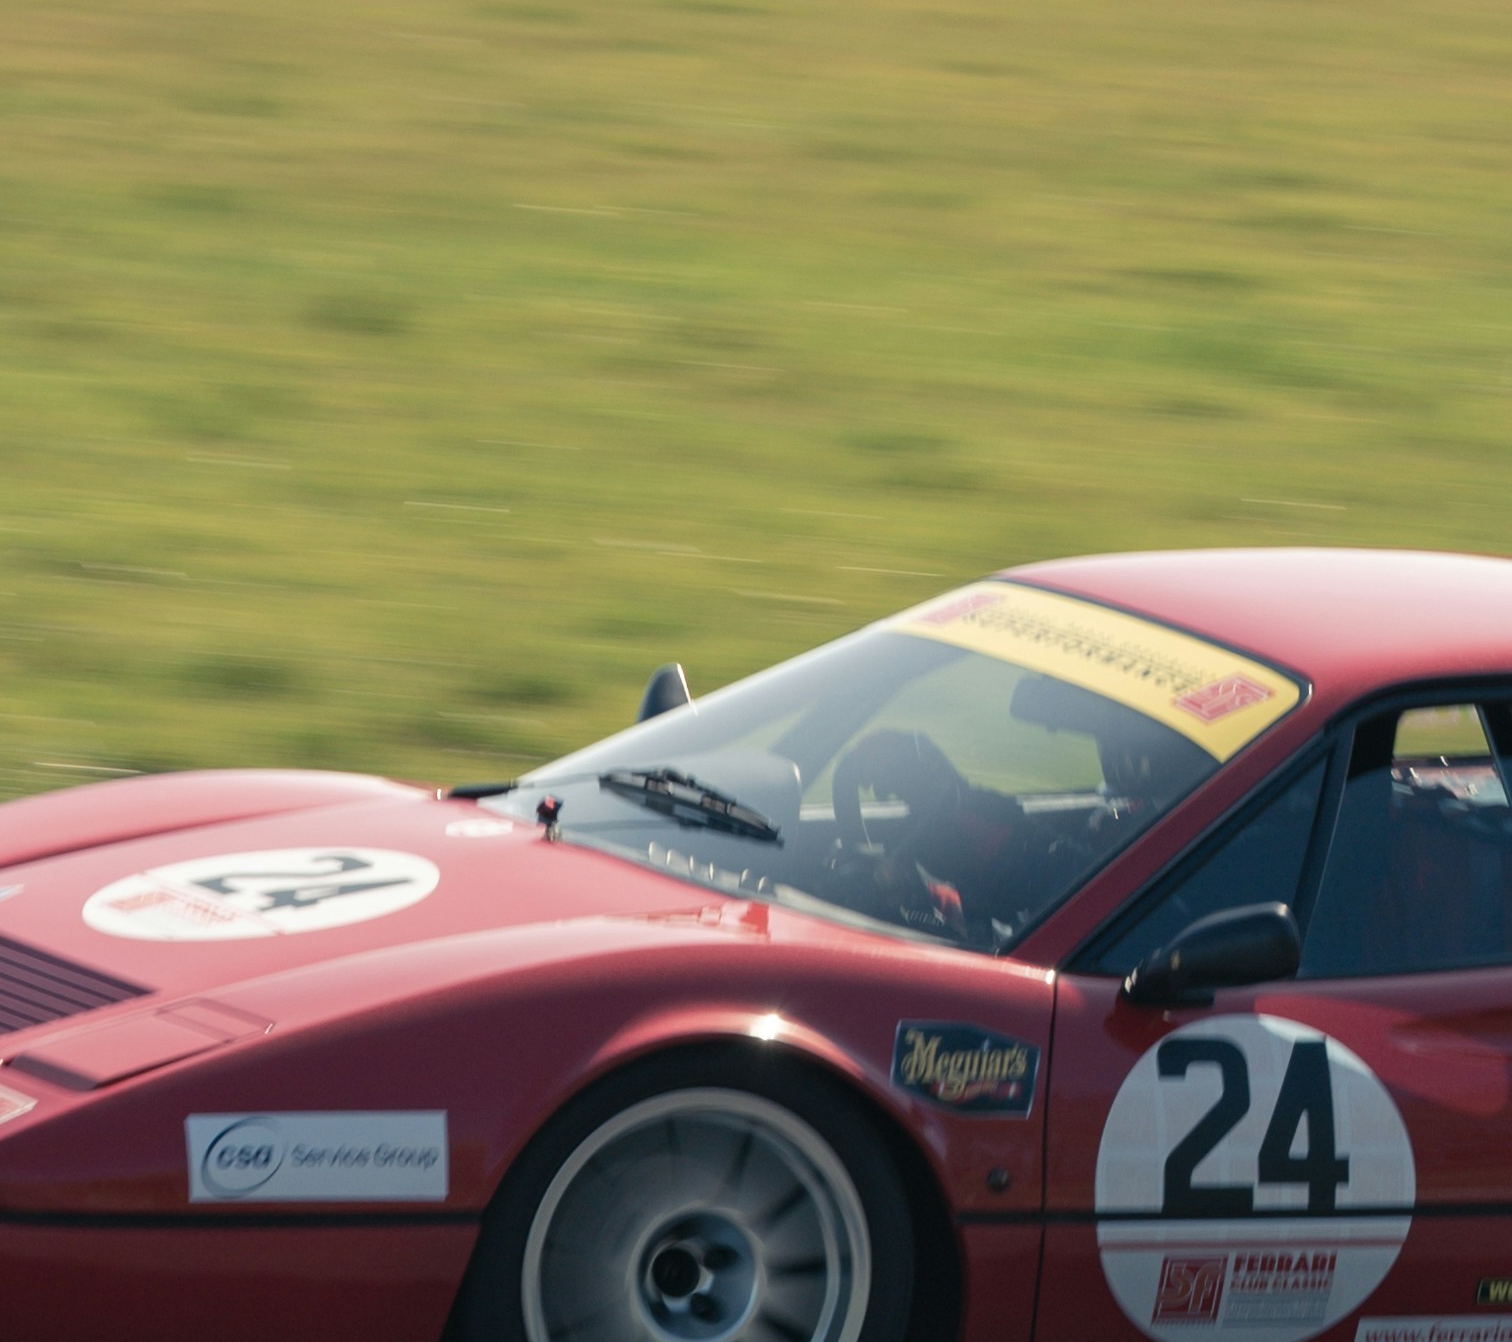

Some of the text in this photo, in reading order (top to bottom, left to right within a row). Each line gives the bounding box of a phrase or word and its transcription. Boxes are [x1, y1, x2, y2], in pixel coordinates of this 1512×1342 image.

[188, 854, 418, 914] 24
[1156, 1036, 1350, 1214] 24
[291, 1142, 370, 1170] Service
[374, 1141, 439, 1171] Group
